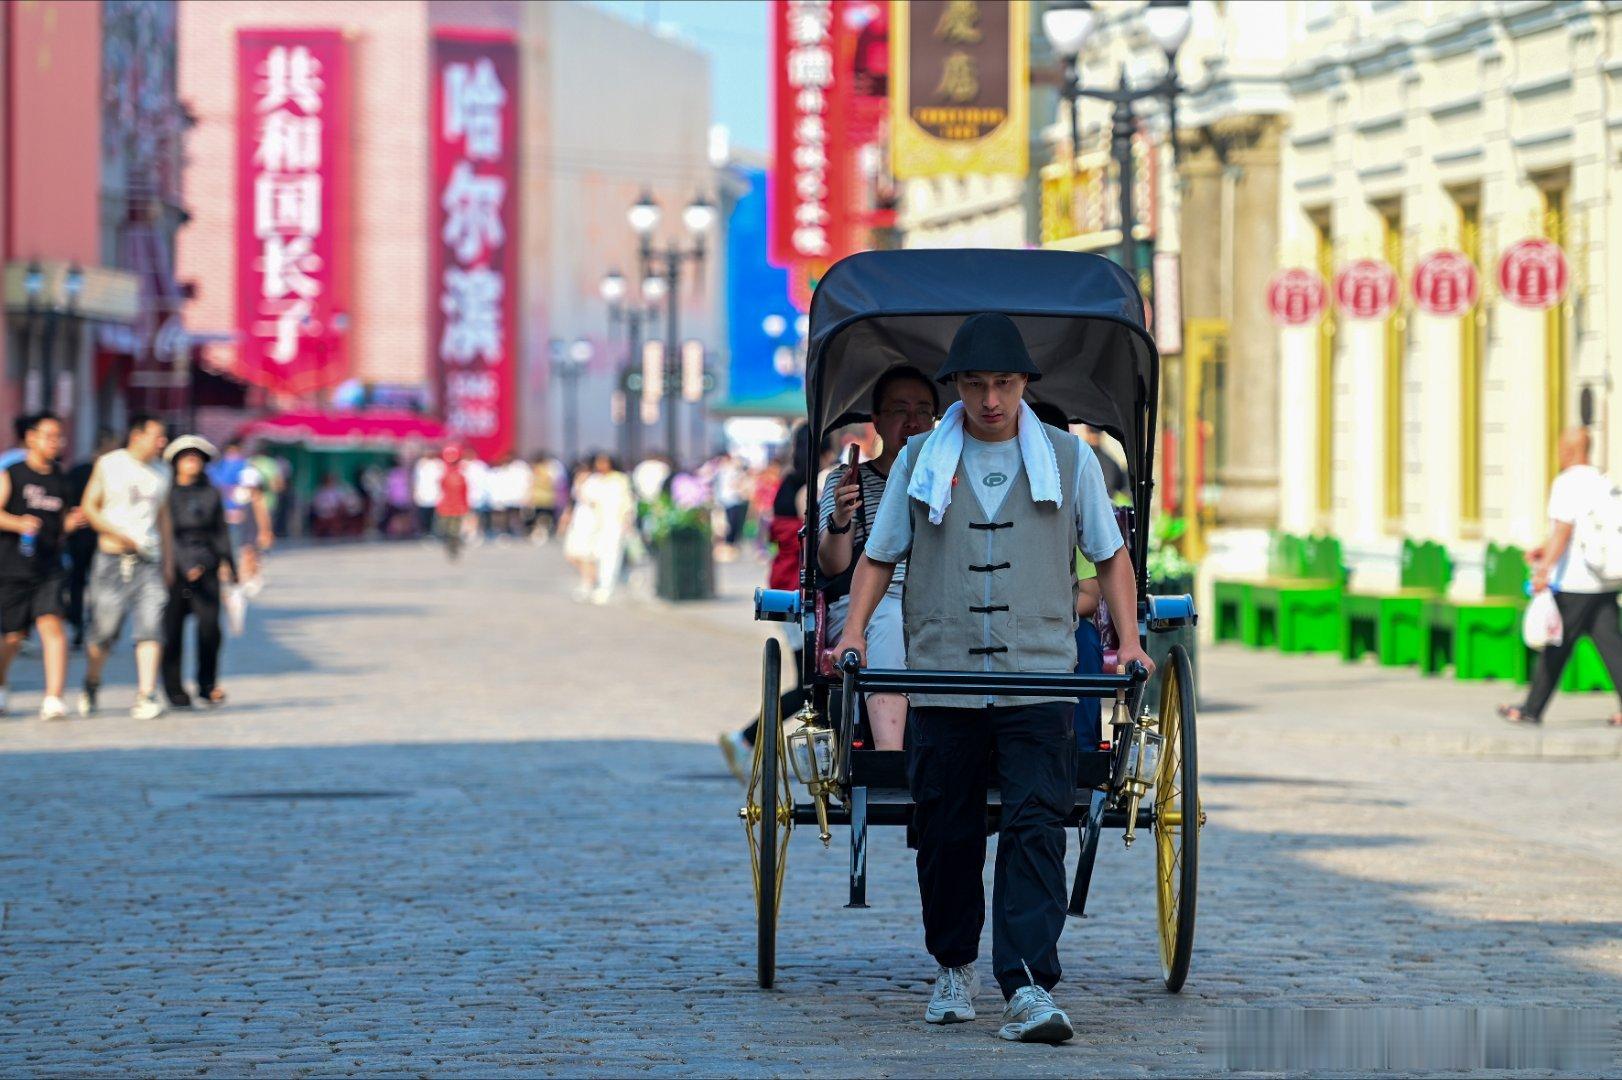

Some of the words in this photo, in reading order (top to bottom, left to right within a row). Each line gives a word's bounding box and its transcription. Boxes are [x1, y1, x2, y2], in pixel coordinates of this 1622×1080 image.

[253, 45, 323, 364] 共和国长子
[440, 57, 507, 364] 哈尔滨
